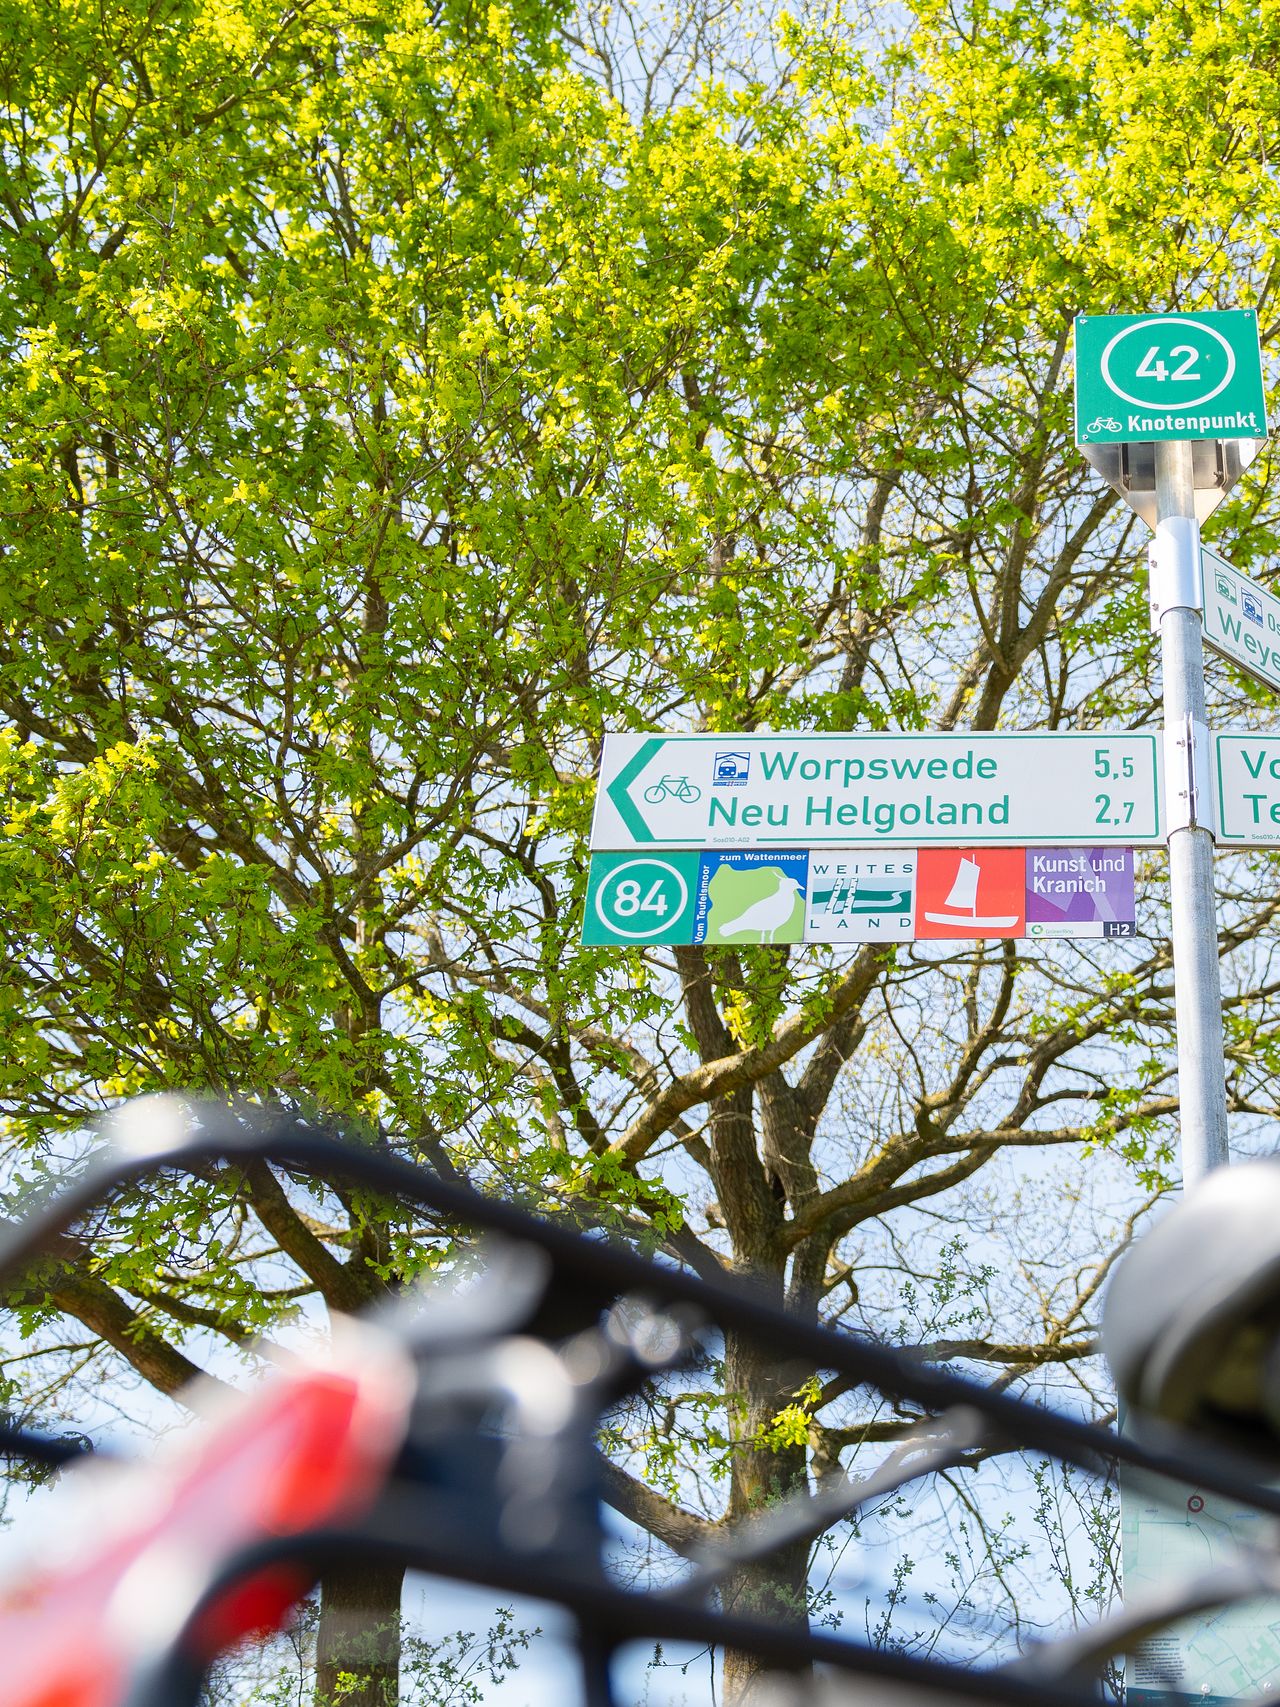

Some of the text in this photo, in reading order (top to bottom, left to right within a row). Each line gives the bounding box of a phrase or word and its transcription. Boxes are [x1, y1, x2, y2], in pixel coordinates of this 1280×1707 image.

[1135, 345, 1201, 382] 42
[1128, 411, 1257, 433] Knotenpunkt
[760, 749, 1134, 788] Worpswede 5,5
[708, 793, 1135, 834] Neu Helgoland 2,7
[744, 853, 807, 862] Wattenmeer
[1033, 855, 1125, 873] Kunst und
[813, 864, 913, 875] WEITES
[1033, 876, 1106, 893] Kranich
[613, 879, 668, 917] 84
[694, 864, 710, 943] Vom Teufelsmoor
[810, 917, 912, 929] LAND
[1109, 923, 1130, 936] H2
